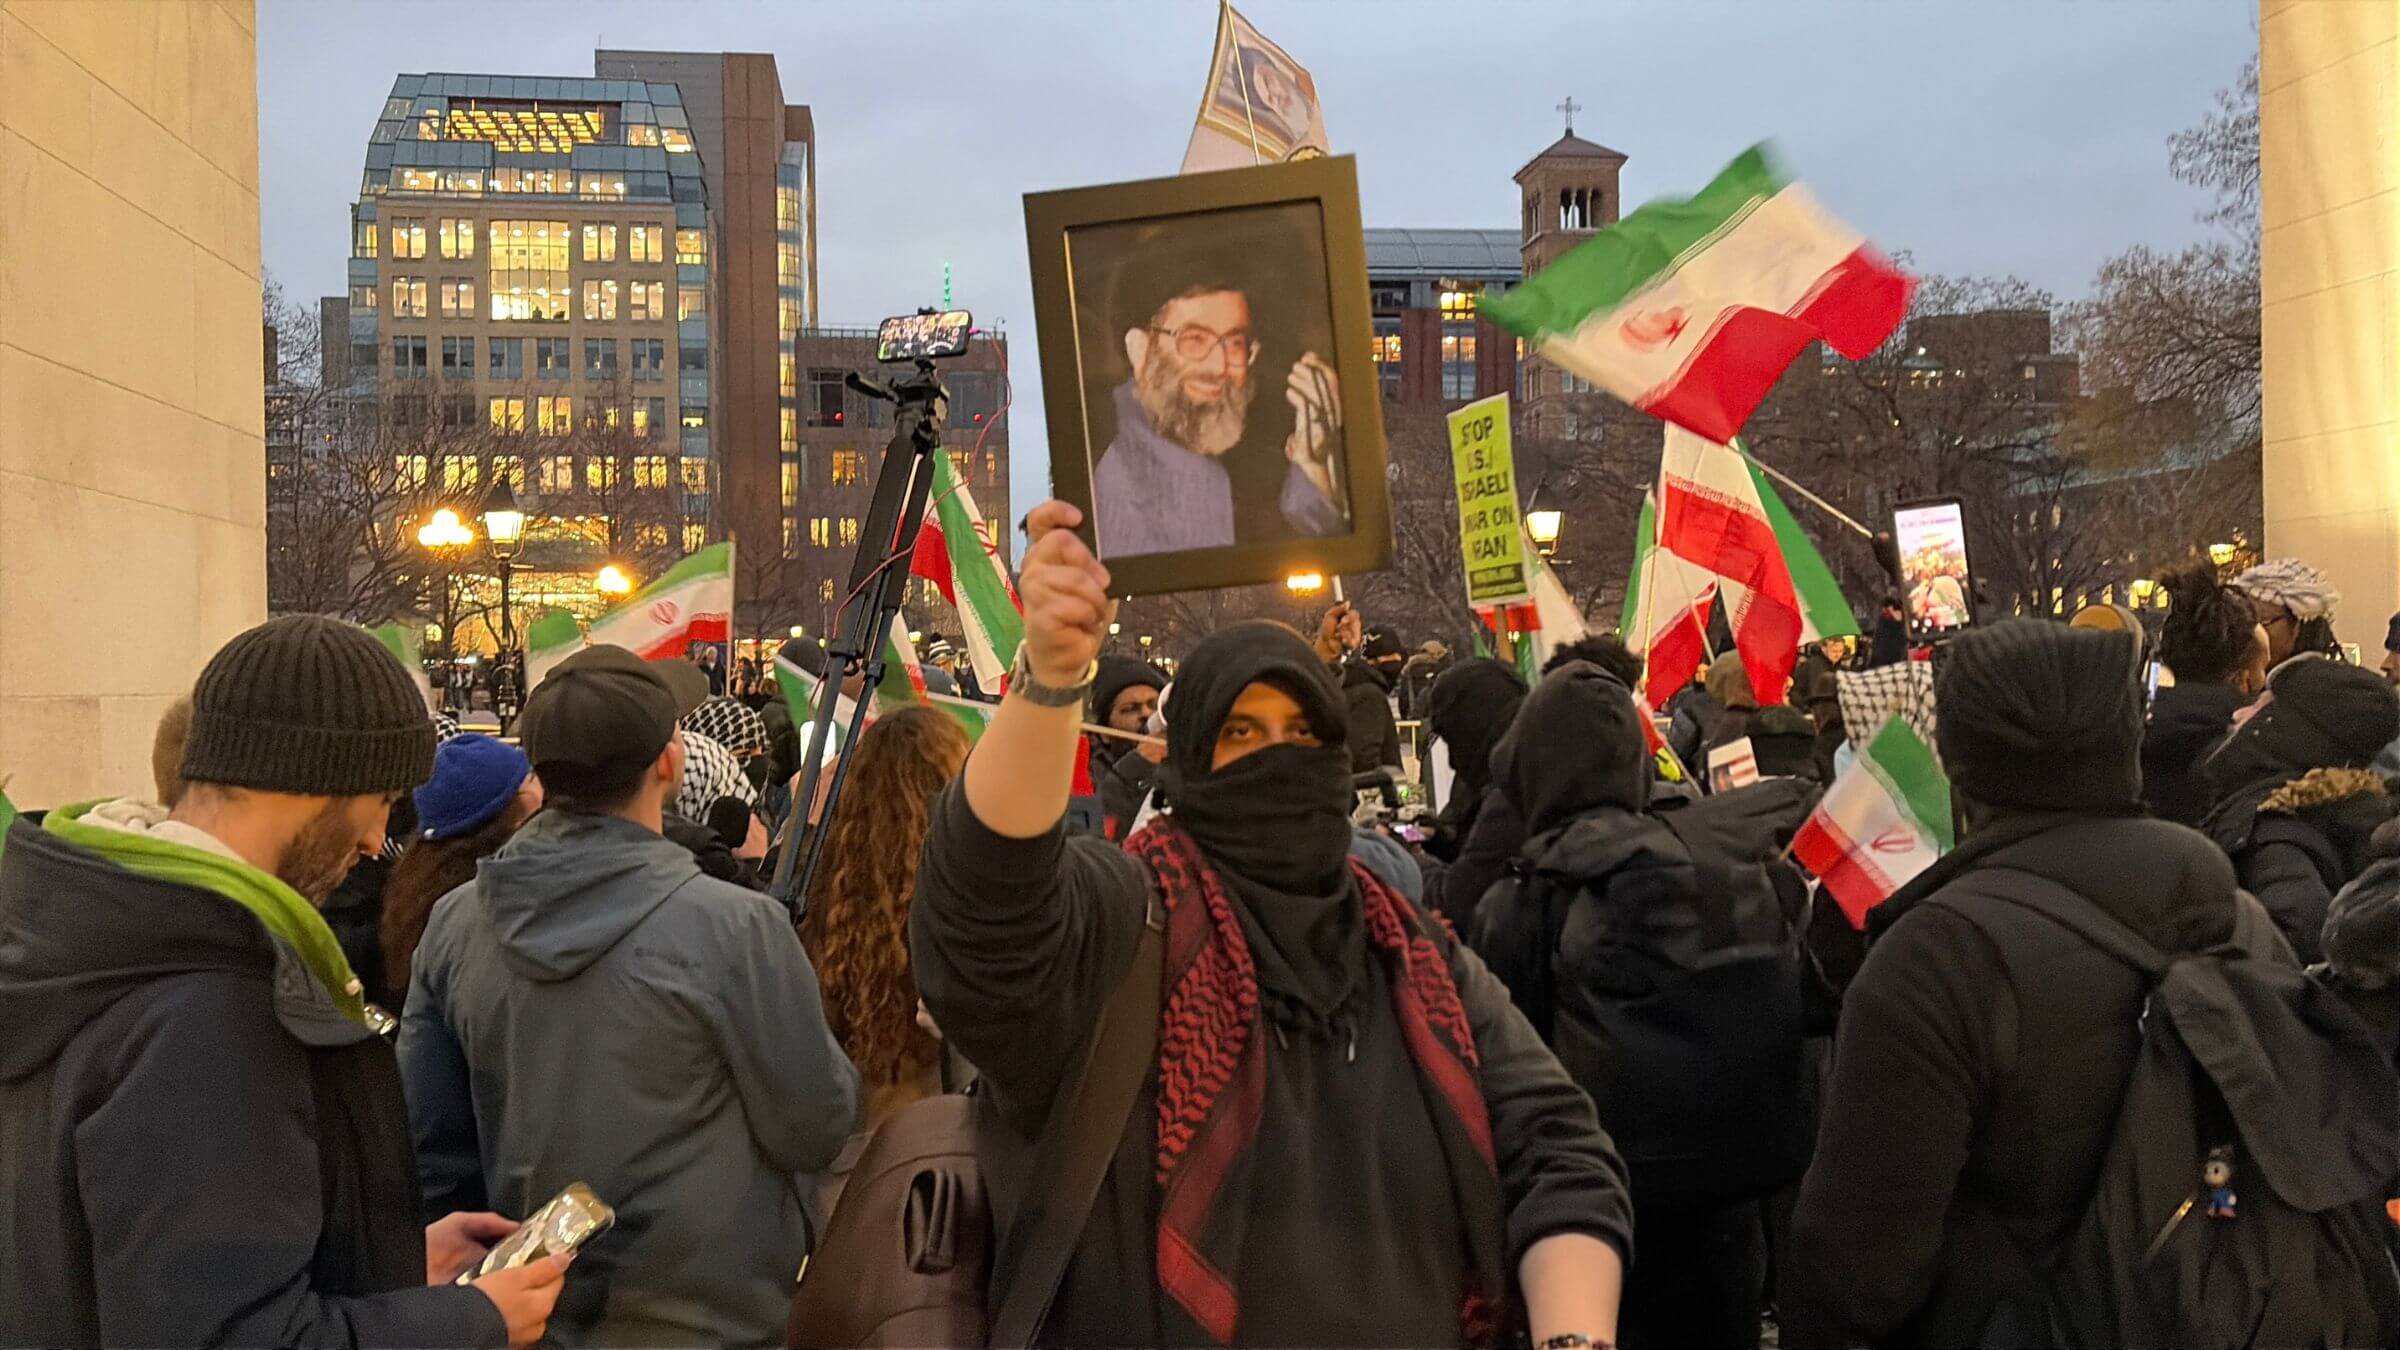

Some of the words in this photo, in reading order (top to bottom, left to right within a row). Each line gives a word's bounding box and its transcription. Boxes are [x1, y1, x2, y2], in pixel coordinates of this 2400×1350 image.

[1461, 416, 1493, 446] SOP
[1493, 505, 1514, 526] ON
[1472, 534, 1507, 561] RAN
